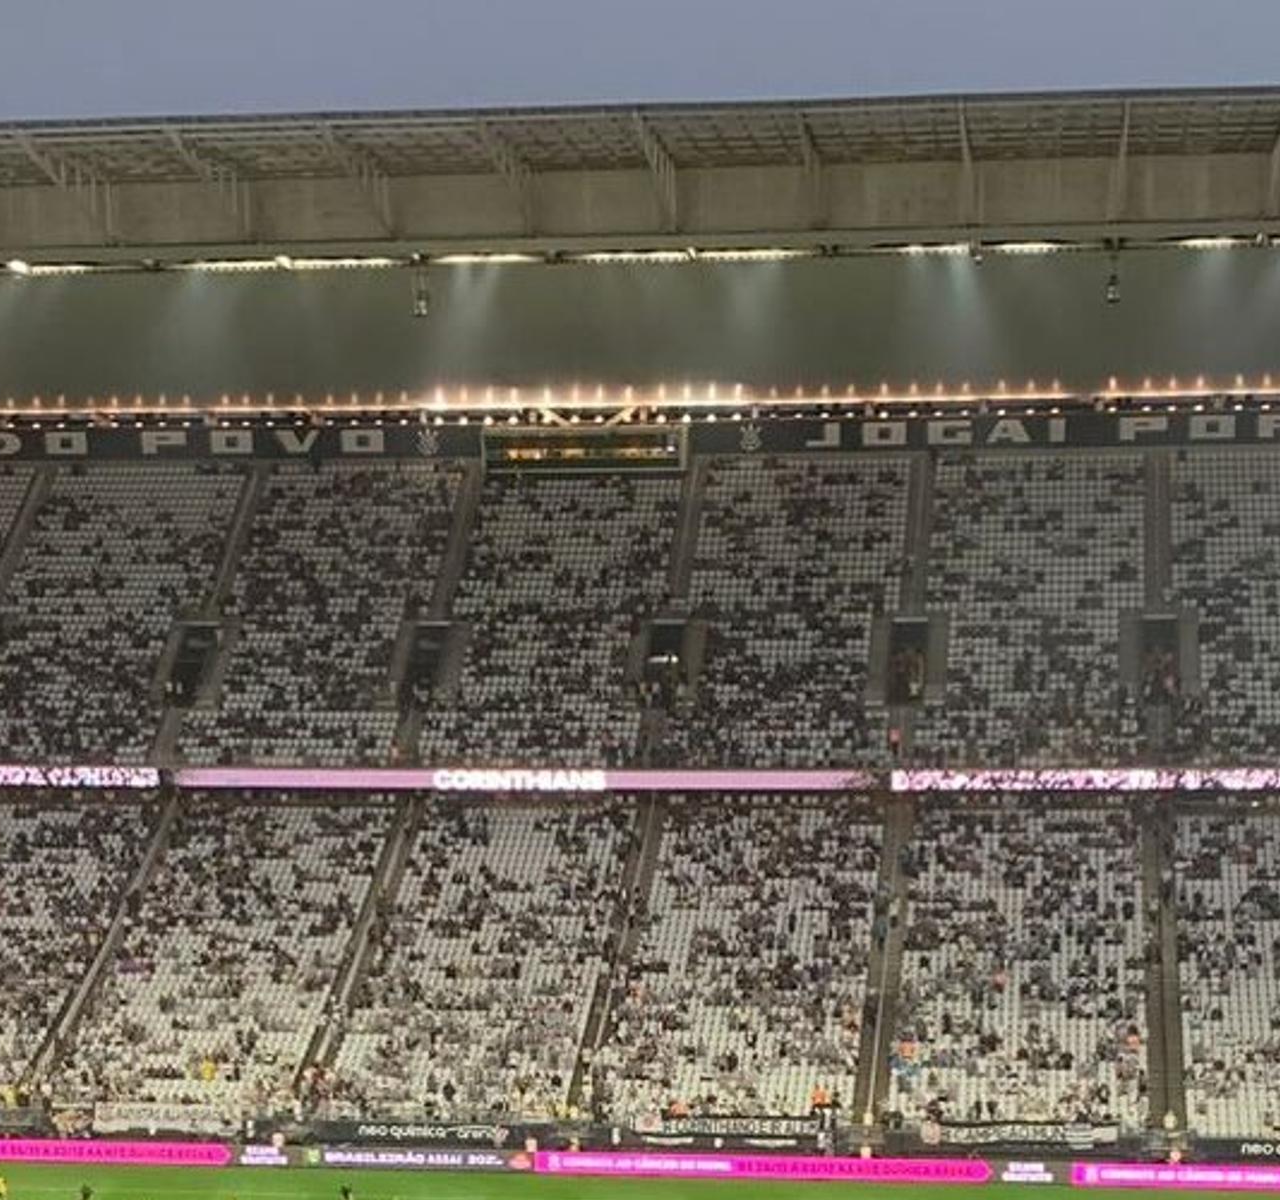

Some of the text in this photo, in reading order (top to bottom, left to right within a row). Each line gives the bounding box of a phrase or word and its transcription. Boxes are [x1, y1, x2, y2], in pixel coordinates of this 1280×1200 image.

[141, 429, 384, 454] POVO
[806, 416, 1066, 446] JOGAI
[433, 769, 607, 790] CORINTHIANS
[357, 1125, 387, 1137] neo
[1240, 1145, 1274, 1156] neo
